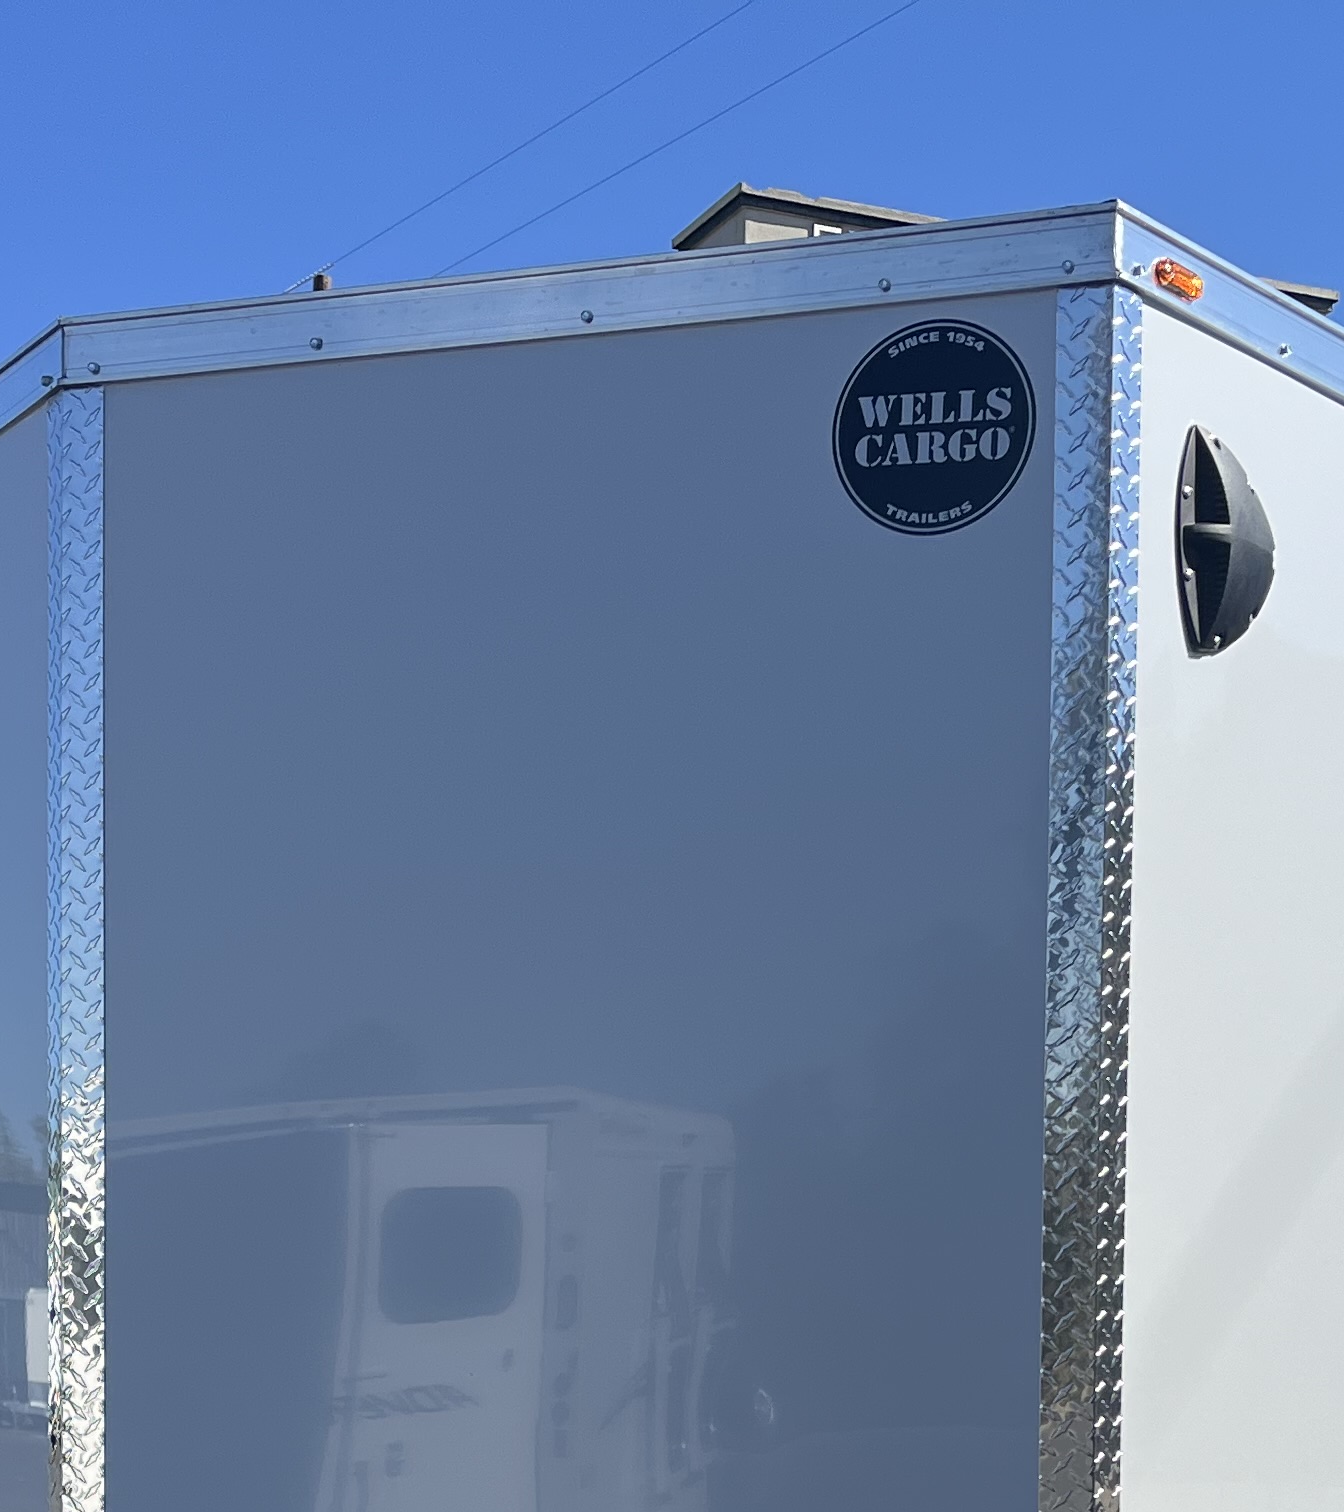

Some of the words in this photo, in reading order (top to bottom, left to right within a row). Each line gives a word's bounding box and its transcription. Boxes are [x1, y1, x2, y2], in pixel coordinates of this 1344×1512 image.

[887, 331, 940, 358] SINCE
[946, 331, 985, 352] 1954
[857, 386, 1013, 429] WELLS
[854, 427, 1011, 468] CARGO
[886, 500, 973, 524] TRAILERS
